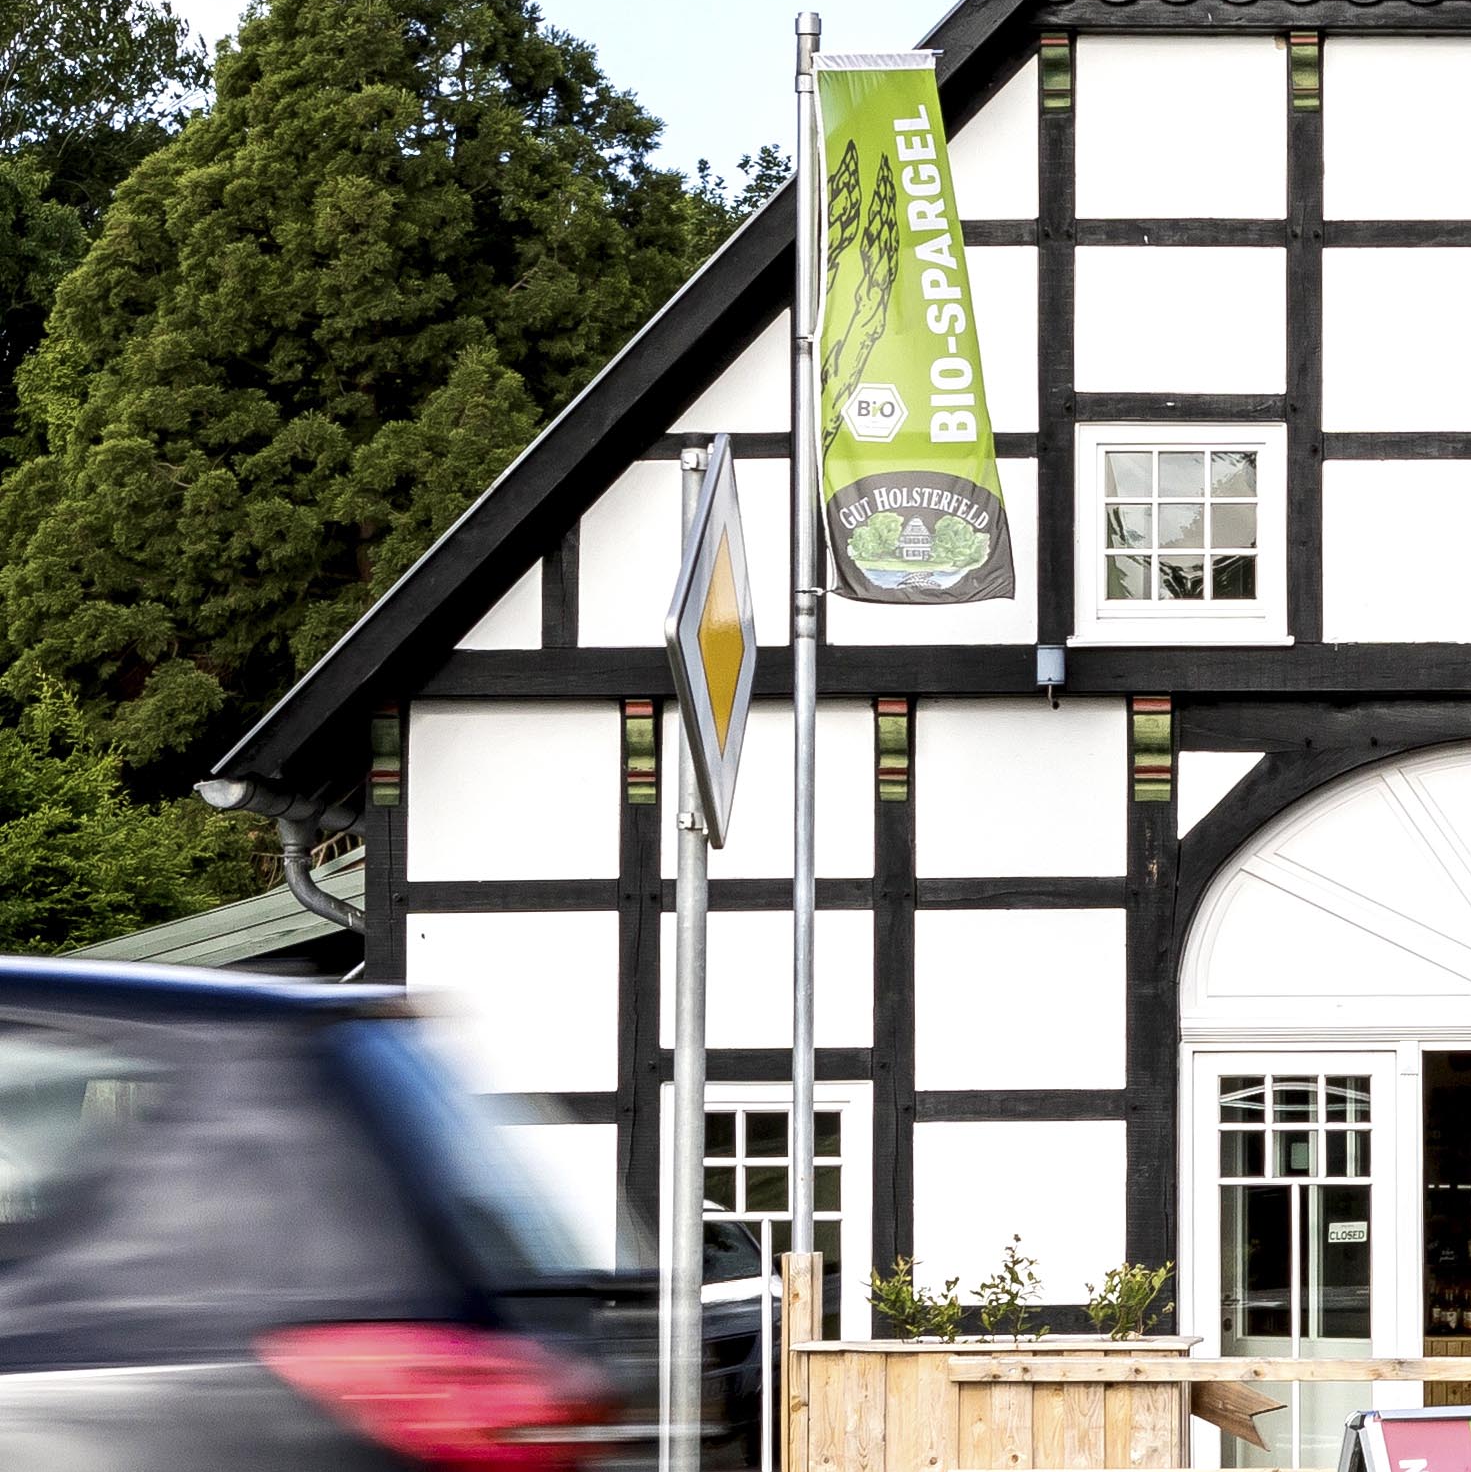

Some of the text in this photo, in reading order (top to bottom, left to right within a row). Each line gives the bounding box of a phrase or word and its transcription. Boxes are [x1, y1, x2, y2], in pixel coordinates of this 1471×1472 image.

[893, 104, 979, 444] BIO-SPARGEL
[838, 487, 991, 531] GUT HOLSTERFELD
[1329, 1230, 1365, 1240] CLOSED
